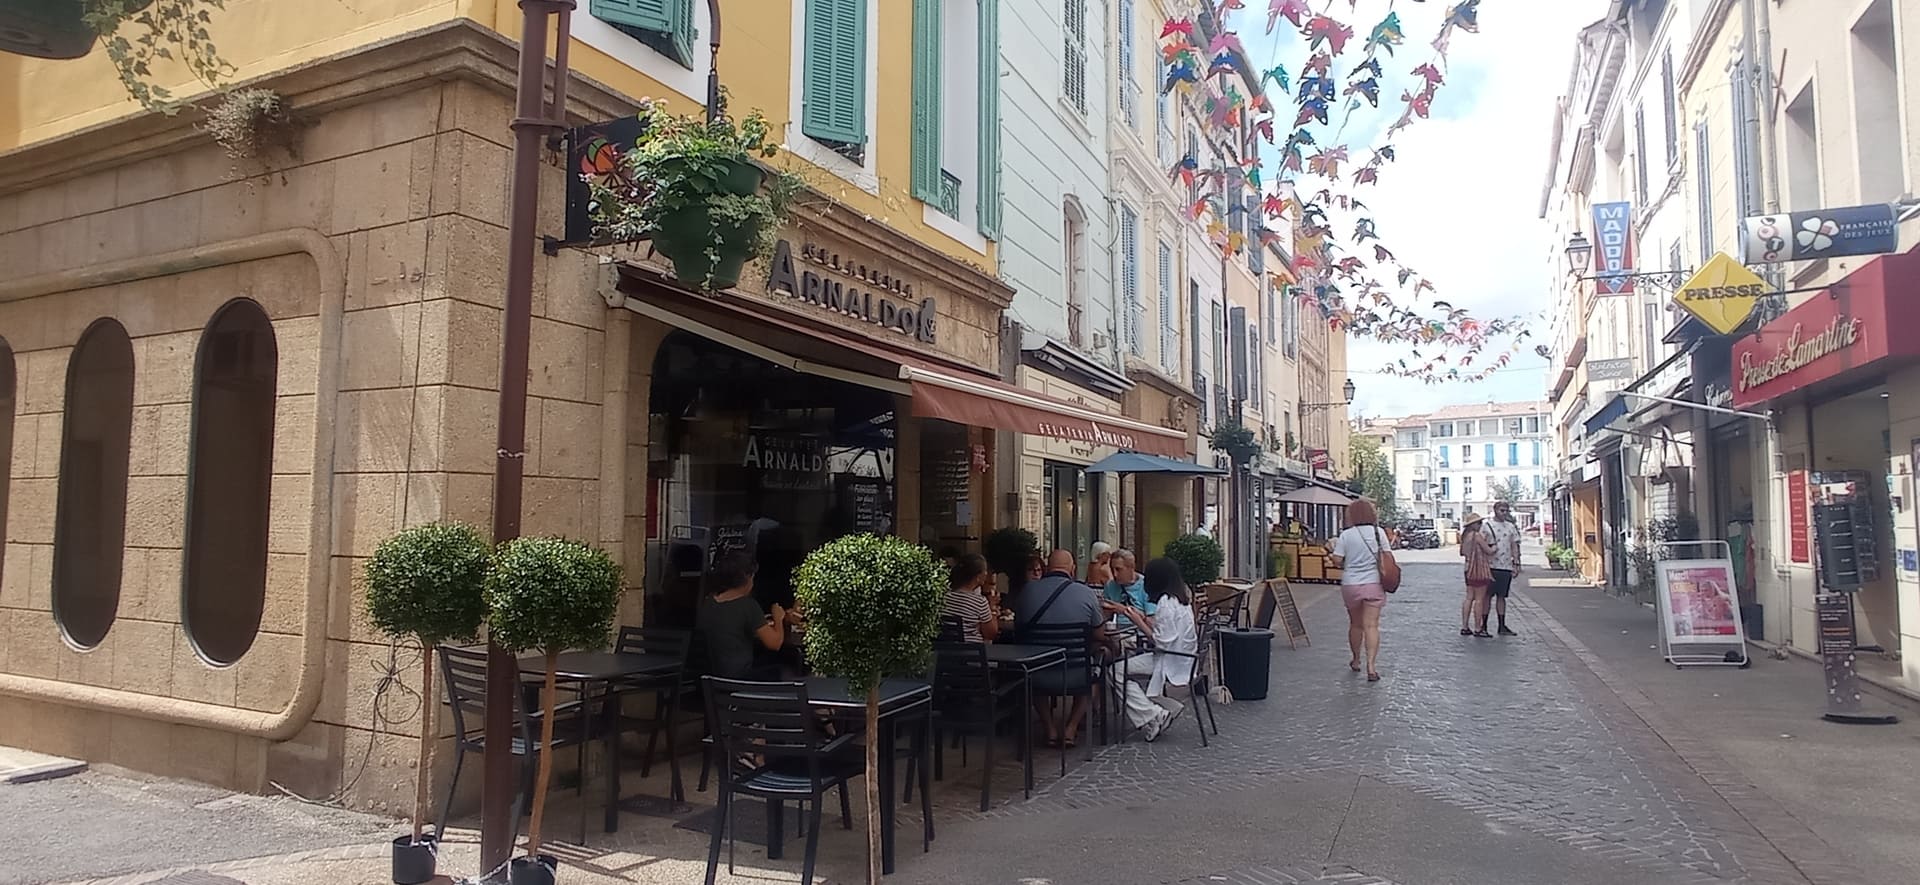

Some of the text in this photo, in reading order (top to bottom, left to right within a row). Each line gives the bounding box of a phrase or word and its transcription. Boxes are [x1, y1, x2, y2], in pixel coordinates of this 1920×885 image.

[1840, 219, 1893, 231] FRANÇAISE
[1844, 228, 1892, 239] DES JEUX
[1600, 207, 1624, 284] MADDOX
[803, 242, 914, 299] GELATERIA
[1685, 283, 1763, 301] PRESSE
[1739, 351, 1775, 393] Presse
[1785, 317, 1858, 373] Lamartine
[1039, 423, 1094, 441] GELATERIA
